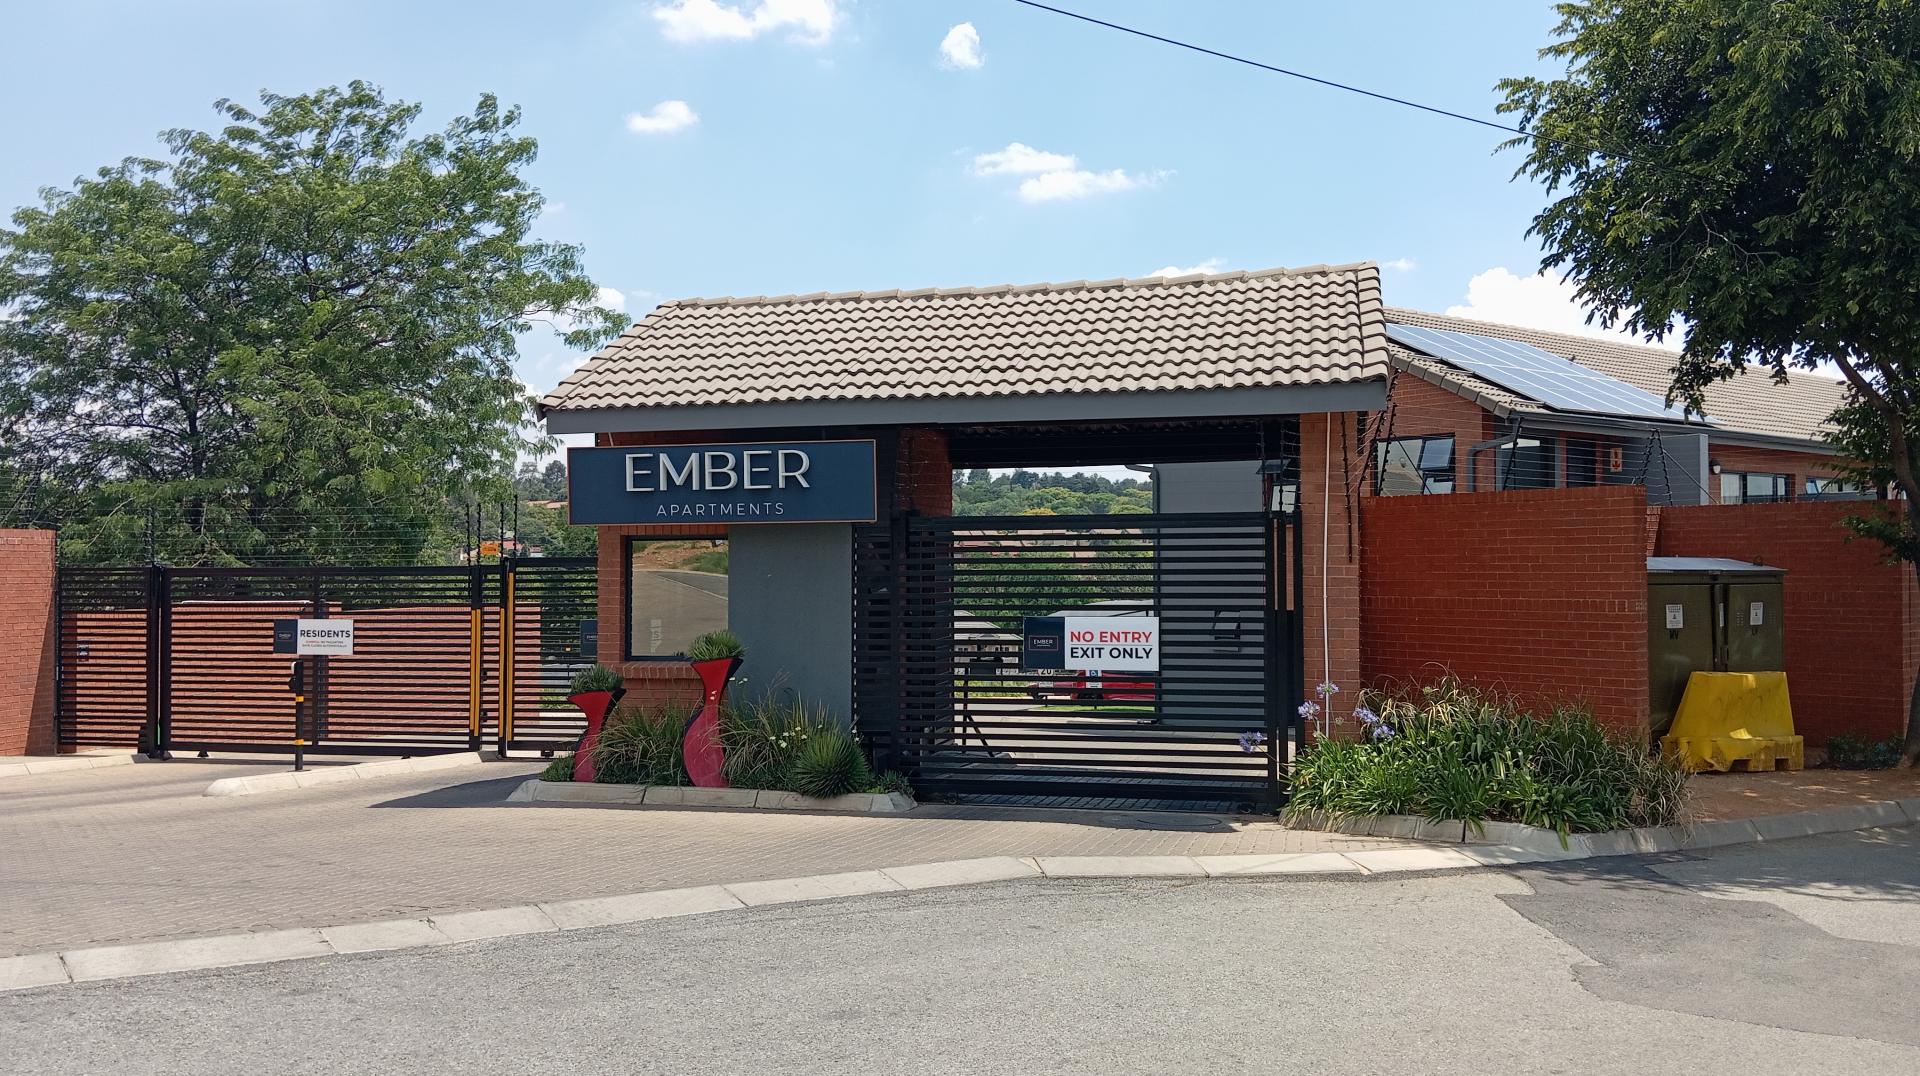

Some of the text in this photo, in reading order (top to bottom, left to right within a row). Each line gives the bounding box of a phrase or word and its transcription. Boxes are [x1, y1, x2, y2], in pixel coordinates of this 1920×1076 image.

[625, 449, 810, 492] EMBER
[656, 502, 784, 517] APARTMENTS
[300, 629, 351, 638] RESIDENTS
[1070, 631, 1153, 643] NO ENTRY
[1070, 647, 1153, 659] EXIT ONLY
